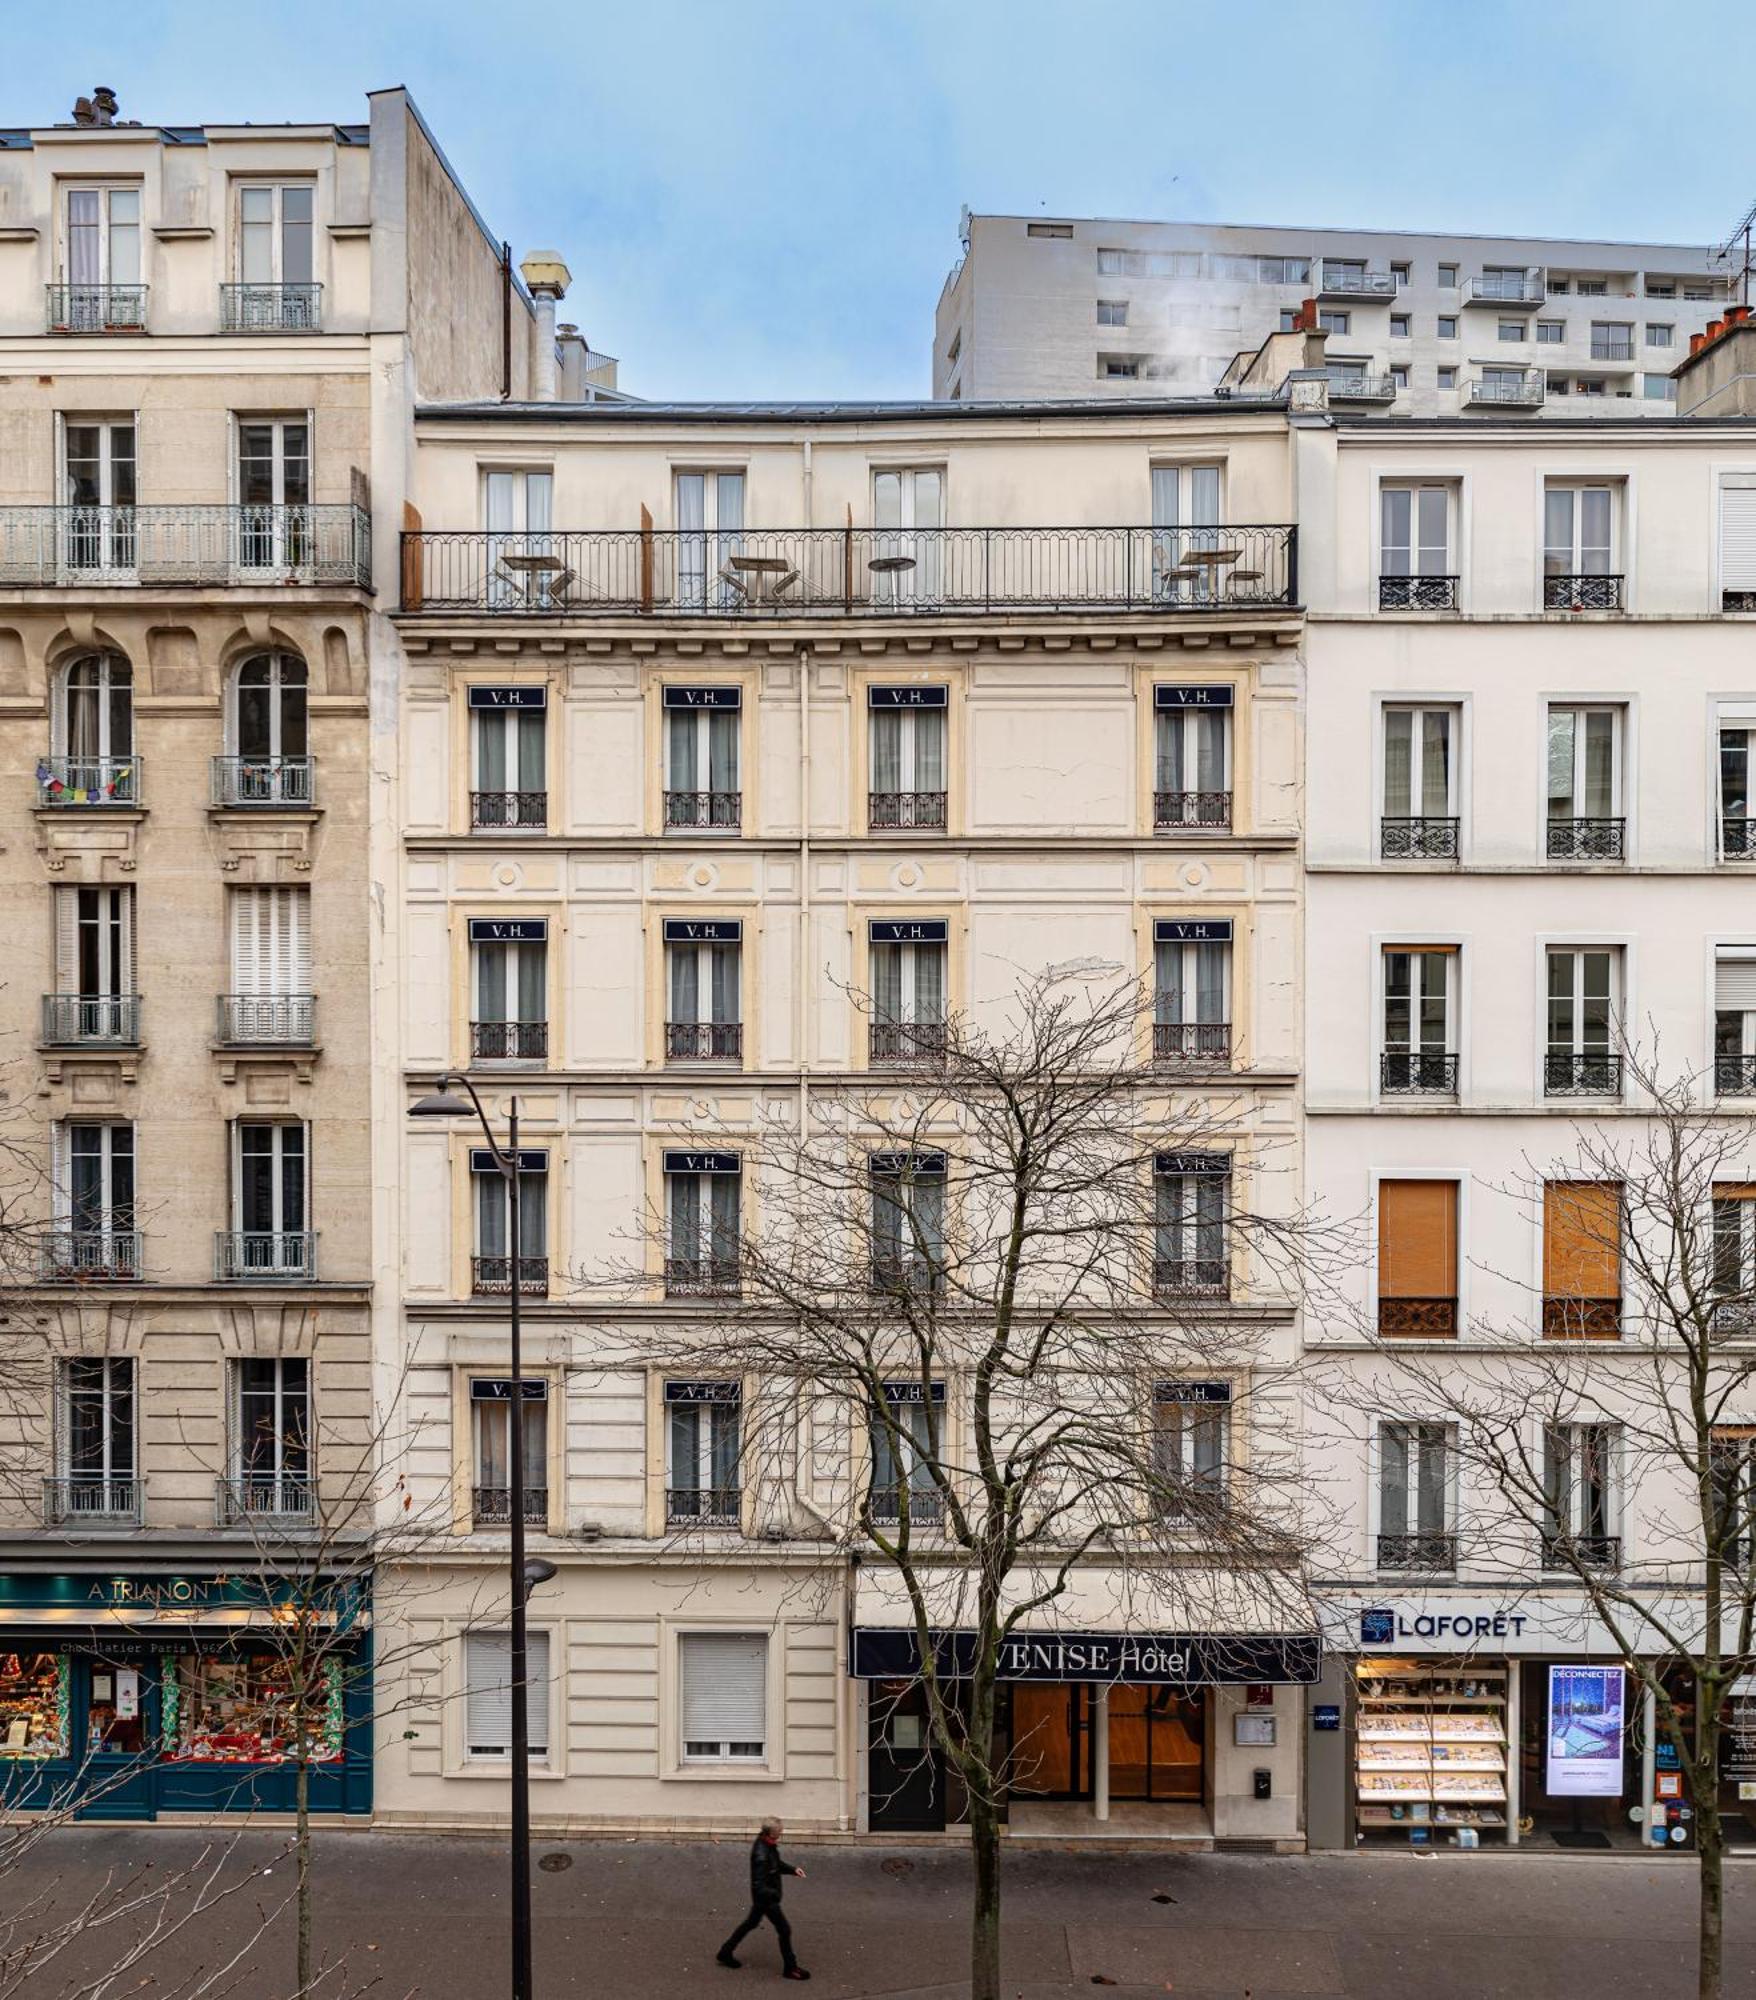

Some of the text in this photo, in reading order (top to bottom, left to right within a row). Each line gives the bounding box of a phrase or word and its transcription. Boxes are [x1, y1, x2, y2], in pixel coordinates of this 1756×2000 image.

[491, 692, 523, 704] V. H.
[686, 692, 718, 704] V. H.
[892, 691, 924, 703] V. H.
[1178, 691, 1210, 703] V. H.
[492, 925, 524, 937] V. H.
[687, 925, 718, 937] V. H.
[892, 926, 924, 938] V. H.
[1177, 925, 1209, 937] V. H.
[687, 1157, 718, 1169] V. H.
[494, 1384, 506, 1396] V.
[892, 1388, 906, 1399] V.
[1196, 1388, 1209, 1399] H.
[88, 1581, 208, 1600] A TRIANON
[151, 1644, 187, 1653] Paris
[995, 1644, 1190, 1673] VENISE Hôtel
